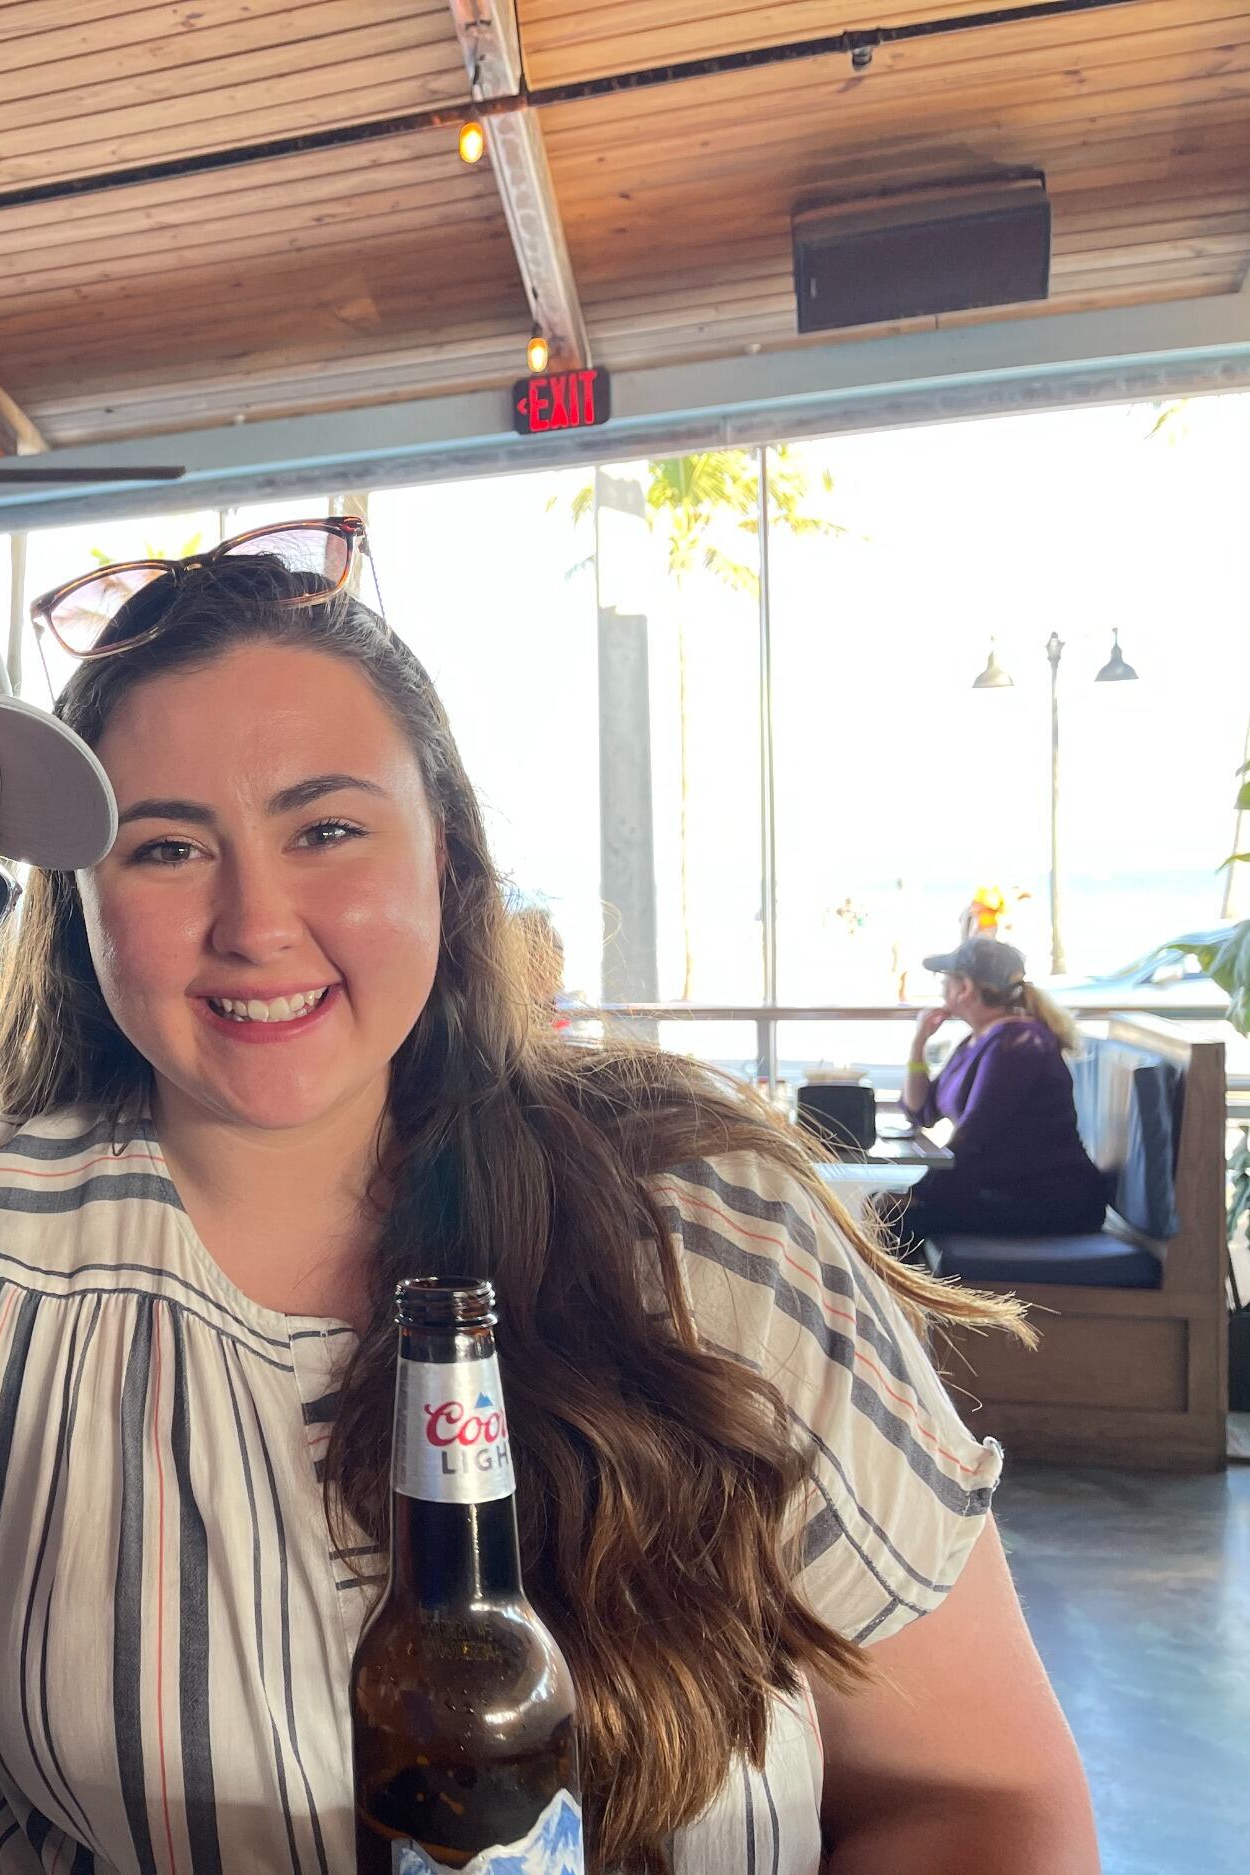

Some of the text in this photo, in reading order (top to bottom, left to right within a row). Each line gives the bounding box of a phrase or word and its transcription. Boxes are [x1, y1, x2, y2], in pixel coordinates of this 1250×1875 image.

[529, 369, 598, 432] EXIT
[423, 1400, 508, 1447] Coo
[441, 1442, 510, 1475] LIGH
